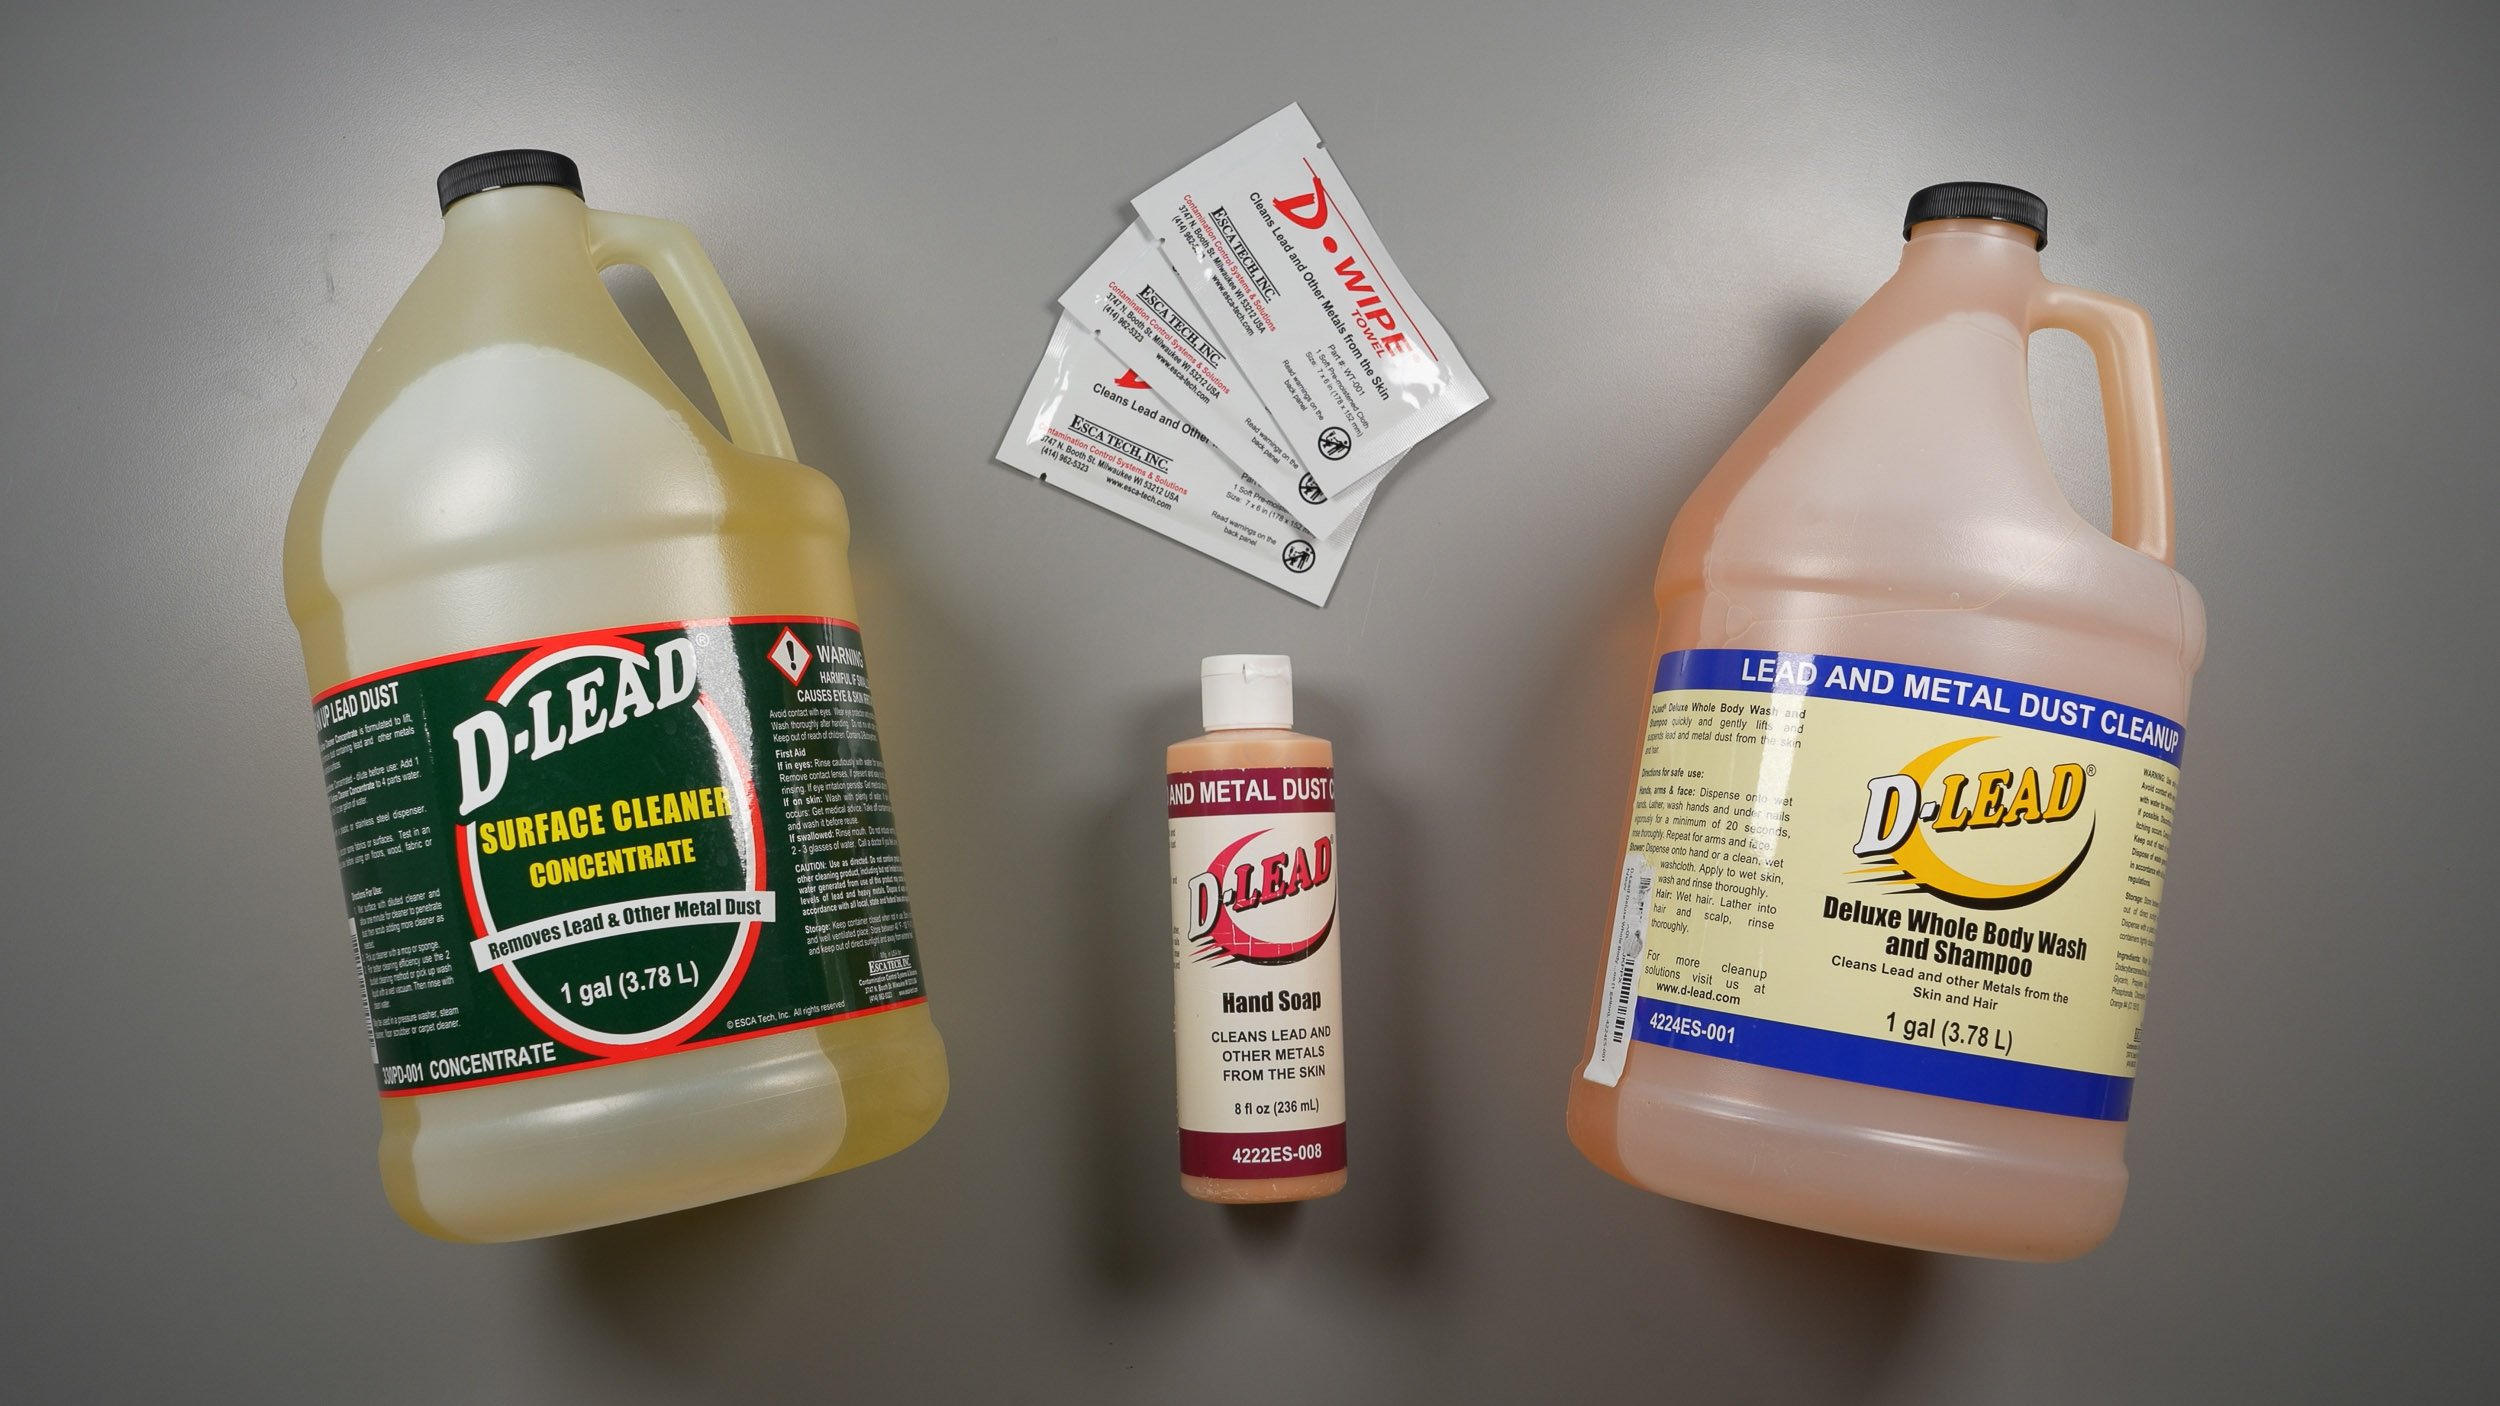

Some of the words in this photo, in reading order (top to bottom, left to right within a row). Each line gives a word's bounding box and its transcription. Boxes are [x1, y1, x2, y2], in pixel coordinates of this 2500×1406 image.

[1178, 204, 1194, 221] 3747
[1188, 219, 1198, 230] N.
[1193, 227, 1210, 249] Booth
[1206, 247, 1216, 259] St.
[1212, 256, 1237, 291] Milwaukee
[1234, 288, 1245, 301] WI
[1240, 298, 1257, 319] 53212
[1252, 316, 1266, 335] USA
[1183, 194, 1217, 242] Contamination
[1214, 240, 1235, 267] Control
[1230, 265, 1252, 294] Systems
[1248, 293, 1257, 301] &
[1253, 299, 1276, 332] Solutions
[1210, 205, 1237, 244] ESCA
[1233, 240, 1260, 278] TECH,
[1255, 275, 1276, 302] INC.
[1211, 274, 1255, 337] www.esca-tech.com
[1249, 192, 1275, 228] Cleans
[1271, 226, 1295, 253] Lead
[1288, 252, 1308, 273] and
[1303, 271, 1326, 300] Other
[1321, 299, 1347, 335] Metals
[1343, 333, 1363, 360] from
[1359, 358, 1374, 377] the
[1371, 375, 1390, 401] Skin
[1136, 283, 1169, 319] ESCA
[1168, 313, 1200, 348] TECH,
[1198, 342, 1221, 367] INC.
[1351, 308, 1385, 359] TOWEL
[1102, 303, 1120, 322] (414)
[1117, 316, 1145, 343] 962-5323
[1155, 352, 1211, 405] www.esca-tech.com
[1327, 343, 1342, 361] Part
[1343, 367, 1366, 397] WT-001
[1093, 382, 1129, 407] Cleans
[1130, 399, 1159, 420] Lead
[1158, 415, 1181, 430] and
[1318, 353, 1331, 368] Soft
[1327, 366, 1360, 412] Pre-moistened
[1356, 411, 1369, 430] Cloth
[1069, 414, 1104, 442] ESCA
[1107, 433, 1142, 460] TECH,
[1143, 451, 1169, 472] INC.
[797, 689, 833, 703] CAUSES
[832, 689, 848, 702] EYE
[847, 690, 853, 703] &
[851, 690, 864, 704] SKIN
[819, 671, 853, 685] HARMFUL
[329, 694, 359, 724] LEAD
[359, 681, 399, 714] DUST
[1741, 656, 1818, 689] LEAD
[1824, 665, 1895, 695] AND
[1903, 673, 2011, 714] METAL
[2019, 692, 2096, 729] DUST
[2100, 709, 2179, 754] CLEANUP
[775, 749, 794, 759] First
[793, 747, 807, 757] Aid
[776, 761, 783, 771] If
[784, 761, 793, 770] in
[794, 761, 813, 771] eyes:
[1169, 782, 1195, 805] AND
[1199, 778, 1277, 804] METAL
[1282, 777, 1328, 801] DUST
[479, 803, 606, 855] SURFACE
[611, 783, 731, 832] CLEANER
[529, 837, 697, 888] CONCENTRATE
[794, 861, 828, 873] CAUTION:
[828, 859, 841, 869] Use
[841, 859, 849, 867] as
[1653, 902, 1667, 914] hair
[1675, 907, 1692, 918] and
[1747, 916, 1775, 930] rinse
[1655, 888, 1673, 900] Hair:
[1676, 890, 1692, 903] Wet
[1695, 893, 1715, 906] hair.
[1720, 896, 1753, 911] Lather
[1757, 902, 1777, 915] into
[487, 925, 562, 961] Removes
[562, 912, 605, 938] Lead
[607, 912, 621, 929] &
[622, 905, 671, 926] Other
[673, 898, 722, 919] Metal
[725, 898, 762, 916] Dust
[1650, 917, 1689, 935] thoroughly.
[1823, 895, 1902, 930] Deluxe
[1907, 908, 1979, 942] Whole
[1982, 921, 2035, 954] Body
[2037, 930, 2088, 961] Wash
[1646, 948, 1661, 961] For
[1675, 956, 1701, 969] more
[1721, 962, 1768, 981] cleanup
[1885, 935, 1930, 961] and
[1933, 939, 2033, 978] Shampoo
[560, 982, 572, 1004] 1
[579, 975, 613, 1007] gal
[618, 965, 672, 1000] (3.78
[676, 960, 699, 988] L)
[1644, 965, 1681, 980] solutions
[1692, 972, 1713, 986] visit
[1725, 979, 1740, 990] us
[1753, 983, 1766, 995] at
[1656, 982, 1741, 1006] www.d-lead.com
[1831, 954, 1877, 973] Cleans
[1881, 962, 1915, 979] Lead
[1917, 971, 1943, 983] and
[1945, 975, 1980, 989] other
[1982, 979, 2021, 997] Metals
[2024, 986, 2050, 1001] from
[2052, 991, 2069, 1005] the
[1912, 986, 1942, 1002] Skin
[1945, 994, 1970, 1006] and
[1972, 995, 1999, 1011] Hair
[734, 1016, 758, 1029] ESCA
[757, 1013, 778, 1023] Tech,
[793, 1007, 803, 1017] All
[802, 1005, 821, 1017] rights
[820, 999, 846, 1012] reserved
[1222, 990, 1274, 1014] Hand
[1278, 989, 1322, 1012] Soap
[1211, 1030, 1268, 1043] CLEANS
[1271, 1028, 1307, 1042] LEAD
[1310, 1025, 1331, 1039] AND
[1649, 1012, 1735, 1044] 4224ES-001
[1886, 1011, 1896, 1033] 1
[1902, 1018, 1936, 1041] gal
[1941, 1020, 1989, 1048] (3.78
[1994, 1028, 2013, 1057] L)
[429, 1041, 557, 1080] CONCENTRATE
[1222, 1049, 1272, 1063] OTHER
[1275, 1045, 1325, 1061] METALS
[1223, 1069, 1264, 1082] FROM
[1267, 1067, 1296, 1081] THE
[1299, 1064, 1326, 1079] SKIN
[1234, 1102, 1242, 1115] 8
[1244, 1102, 1253, 1115] fl
[1255, 1104, 1271, 1115] oz
[1273, 1100, 1298, 1117] (236
[1300, 1097, 1320, 1114] mL)
[1232, 1143, 1322, 1164] 4222ES-008
